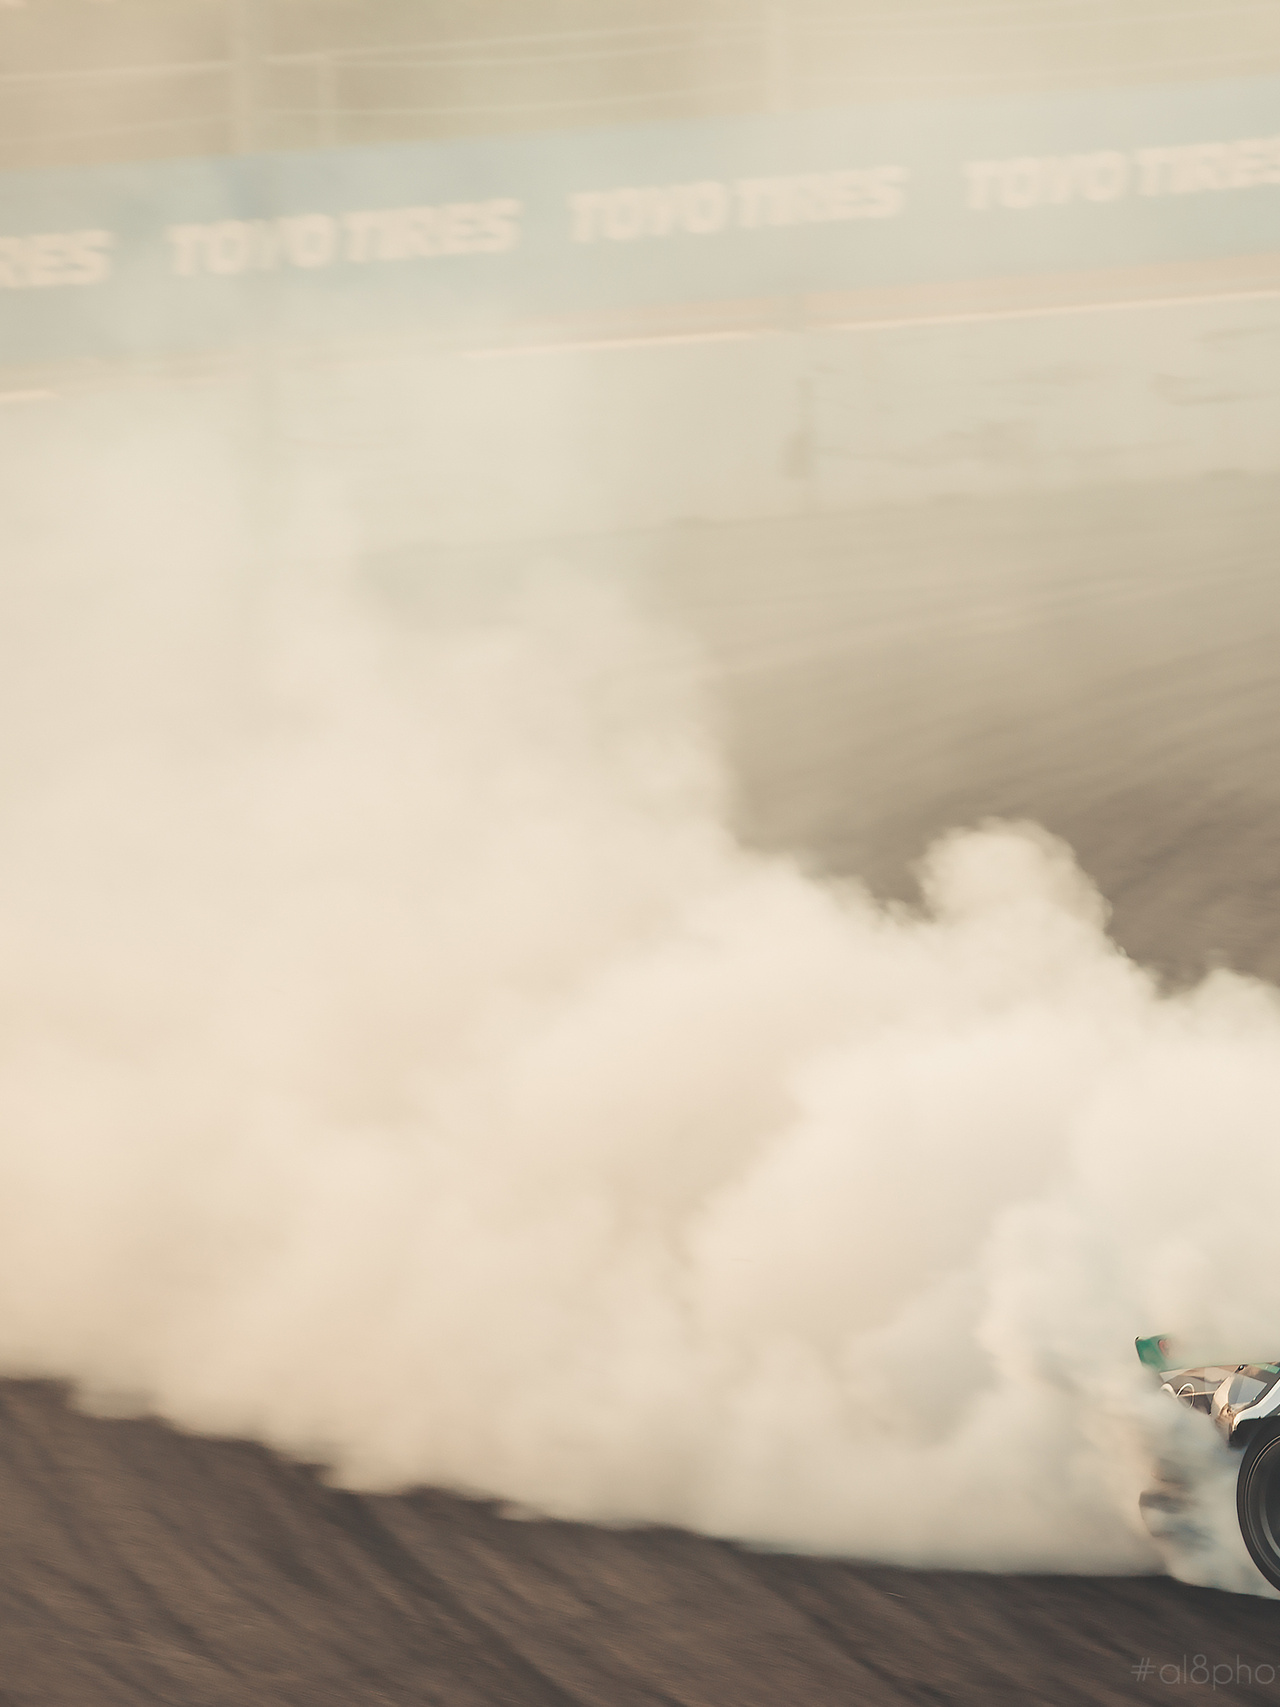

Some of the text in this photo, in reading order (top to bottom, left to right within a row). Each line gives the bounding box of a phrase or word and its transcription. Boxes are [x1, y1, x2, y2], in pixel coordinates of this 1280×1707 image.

[570, 164, 908, 243] TOYO TIRES
[962, 149, 1126, 209] TOYO
[166, 198, 522, 276] TOYO TIRES
